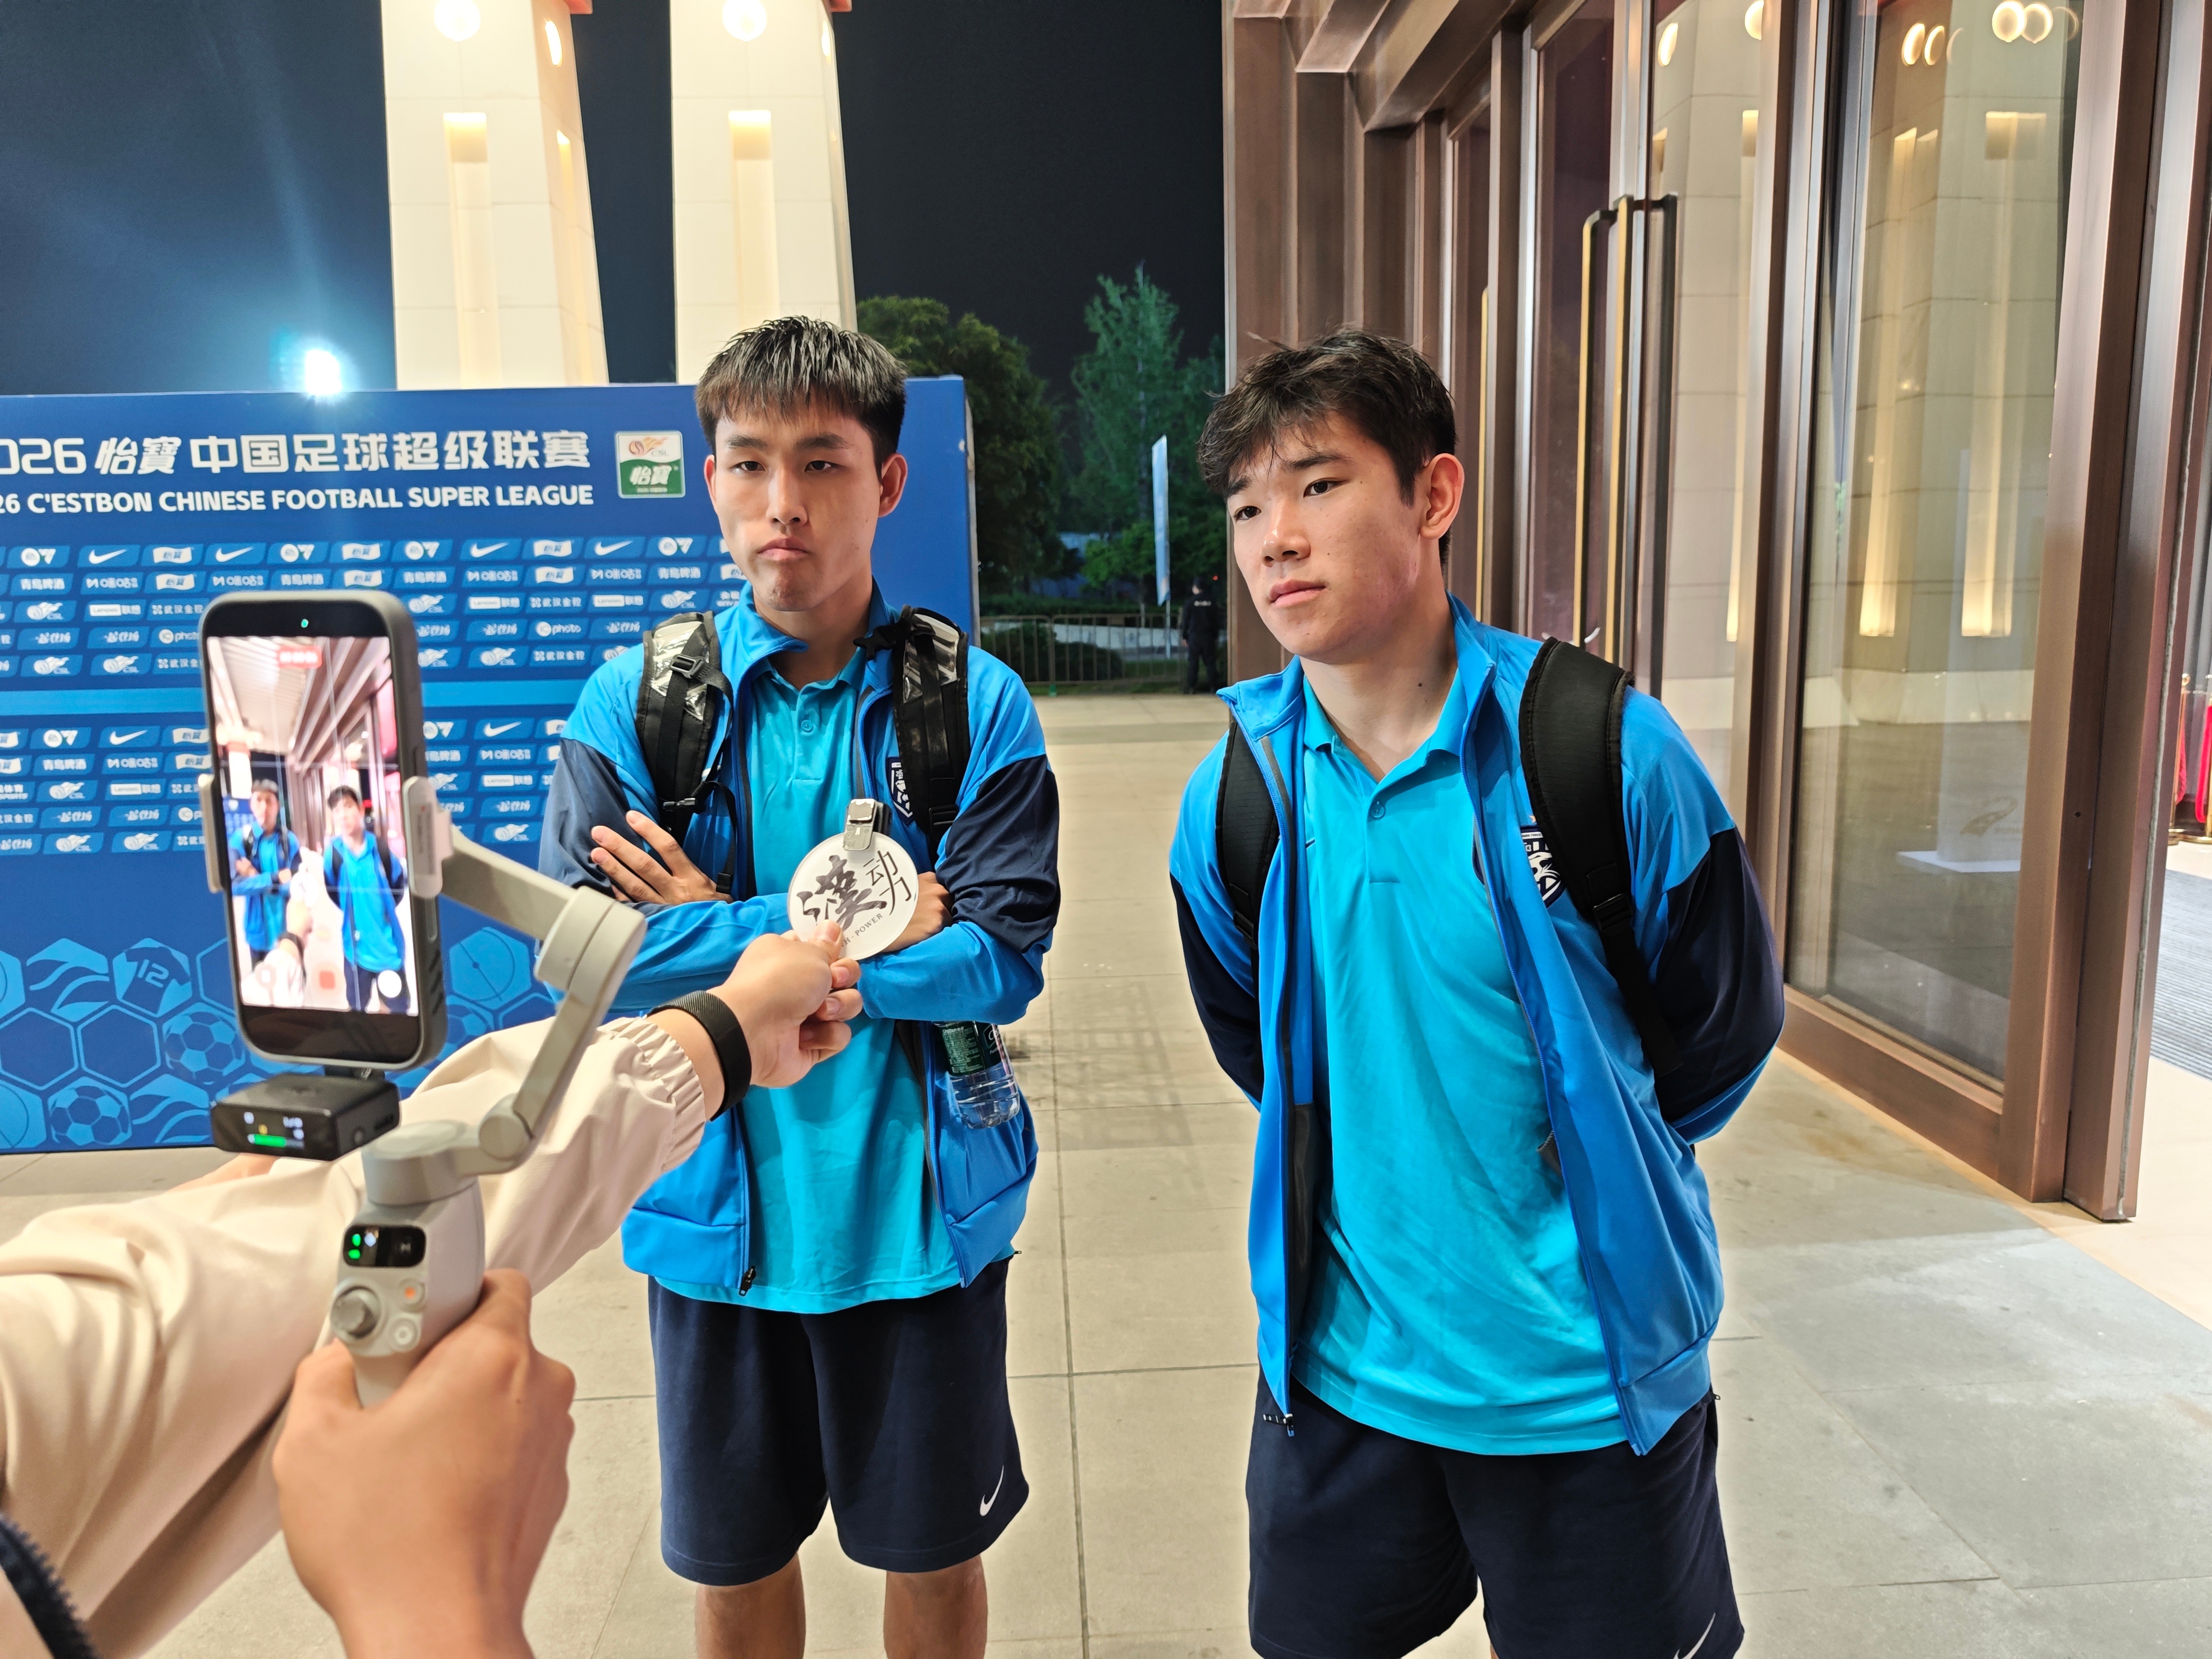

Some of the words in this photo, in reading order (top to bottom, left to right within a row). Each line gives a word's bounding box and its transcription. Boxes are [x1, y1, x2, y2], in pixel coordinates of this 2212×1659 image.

[190, 430, 590, 474] 中国足球超级联赛
[28, 492, 152, 514] C'ESTBON
[159, 490, 266, 512] CHINESE
[272, 488, 403, 510] FOOTBALL
[408, 486, 490, 508] SUPER
[496, 485, 594, 506] LEAGUE
[854, 913, 883, 936] POWER
